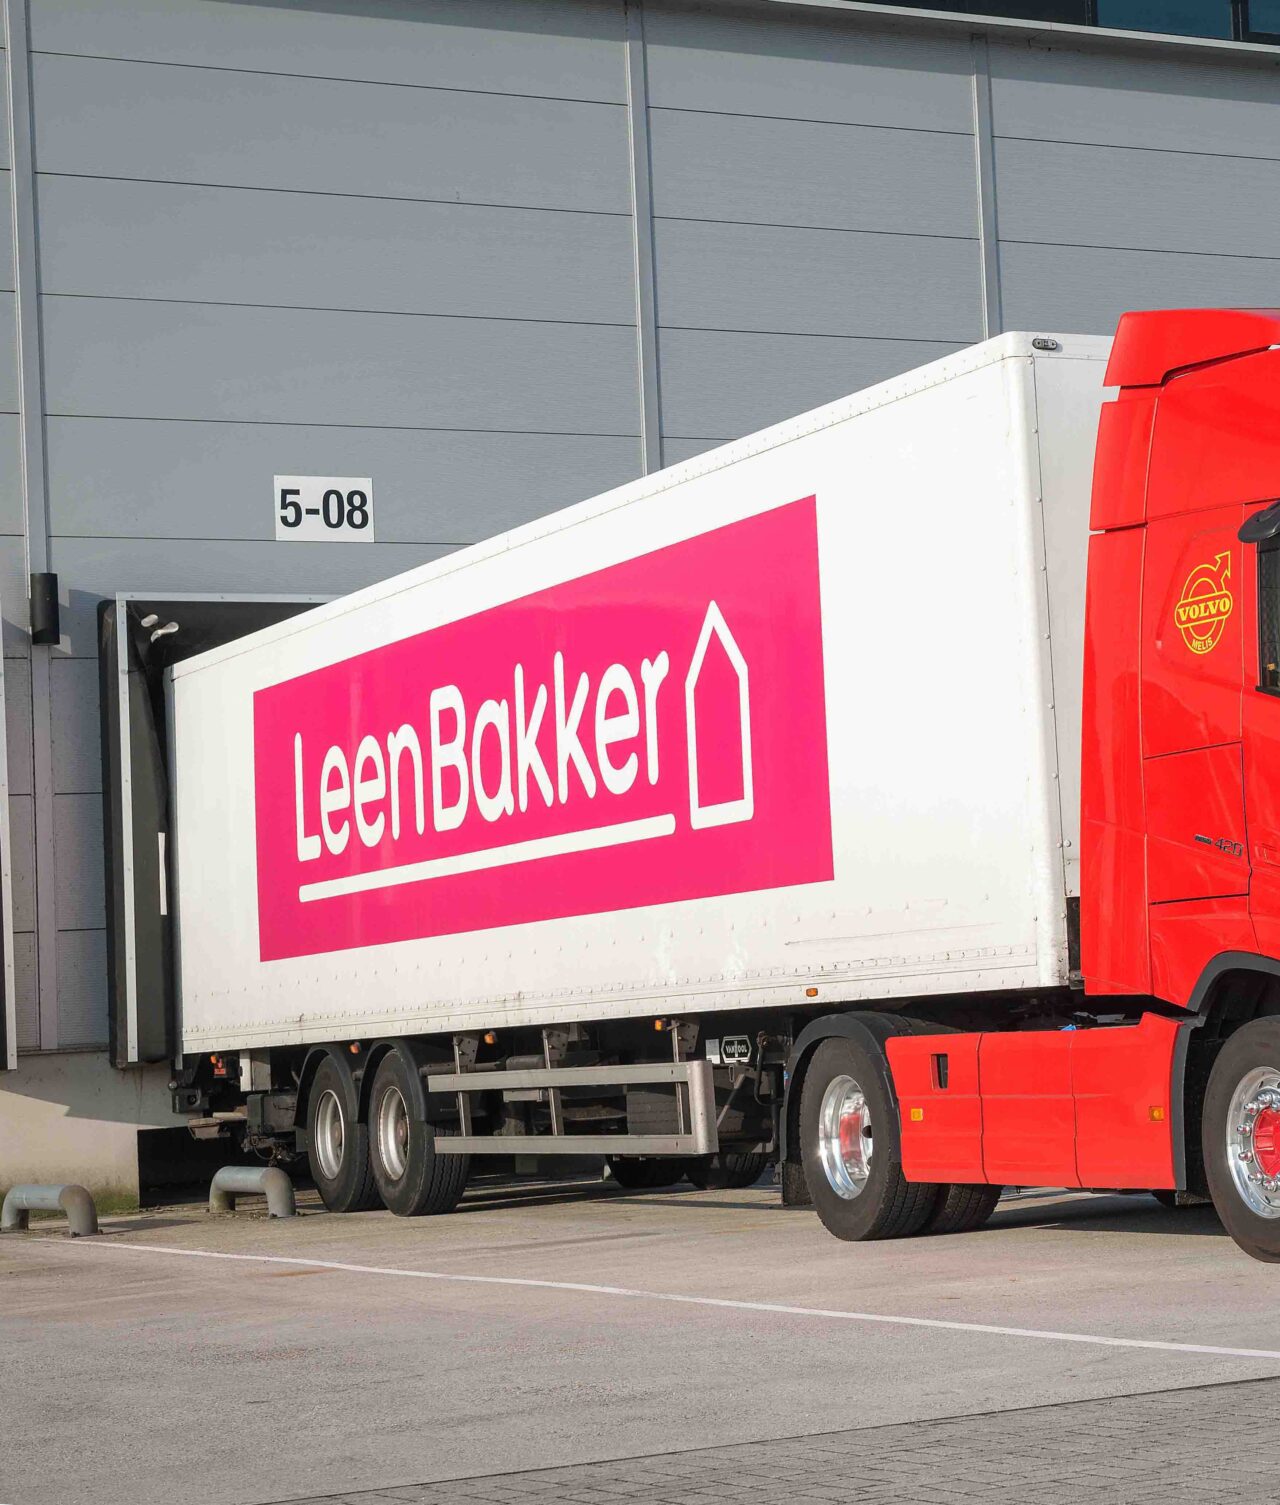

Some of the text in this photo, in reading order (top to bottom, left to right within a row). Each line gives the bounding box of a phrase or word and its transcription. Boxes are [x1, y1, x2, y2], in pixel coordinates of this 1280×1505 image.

[279, 488, 369, 529] 5-08
[1177, 597, 1230, 622] VOLVO
[1191, 637, 1213, 651] MELIS
[294, 650, 670, 862] LeenBakker
[1215, 838, 1243, 857] 420
